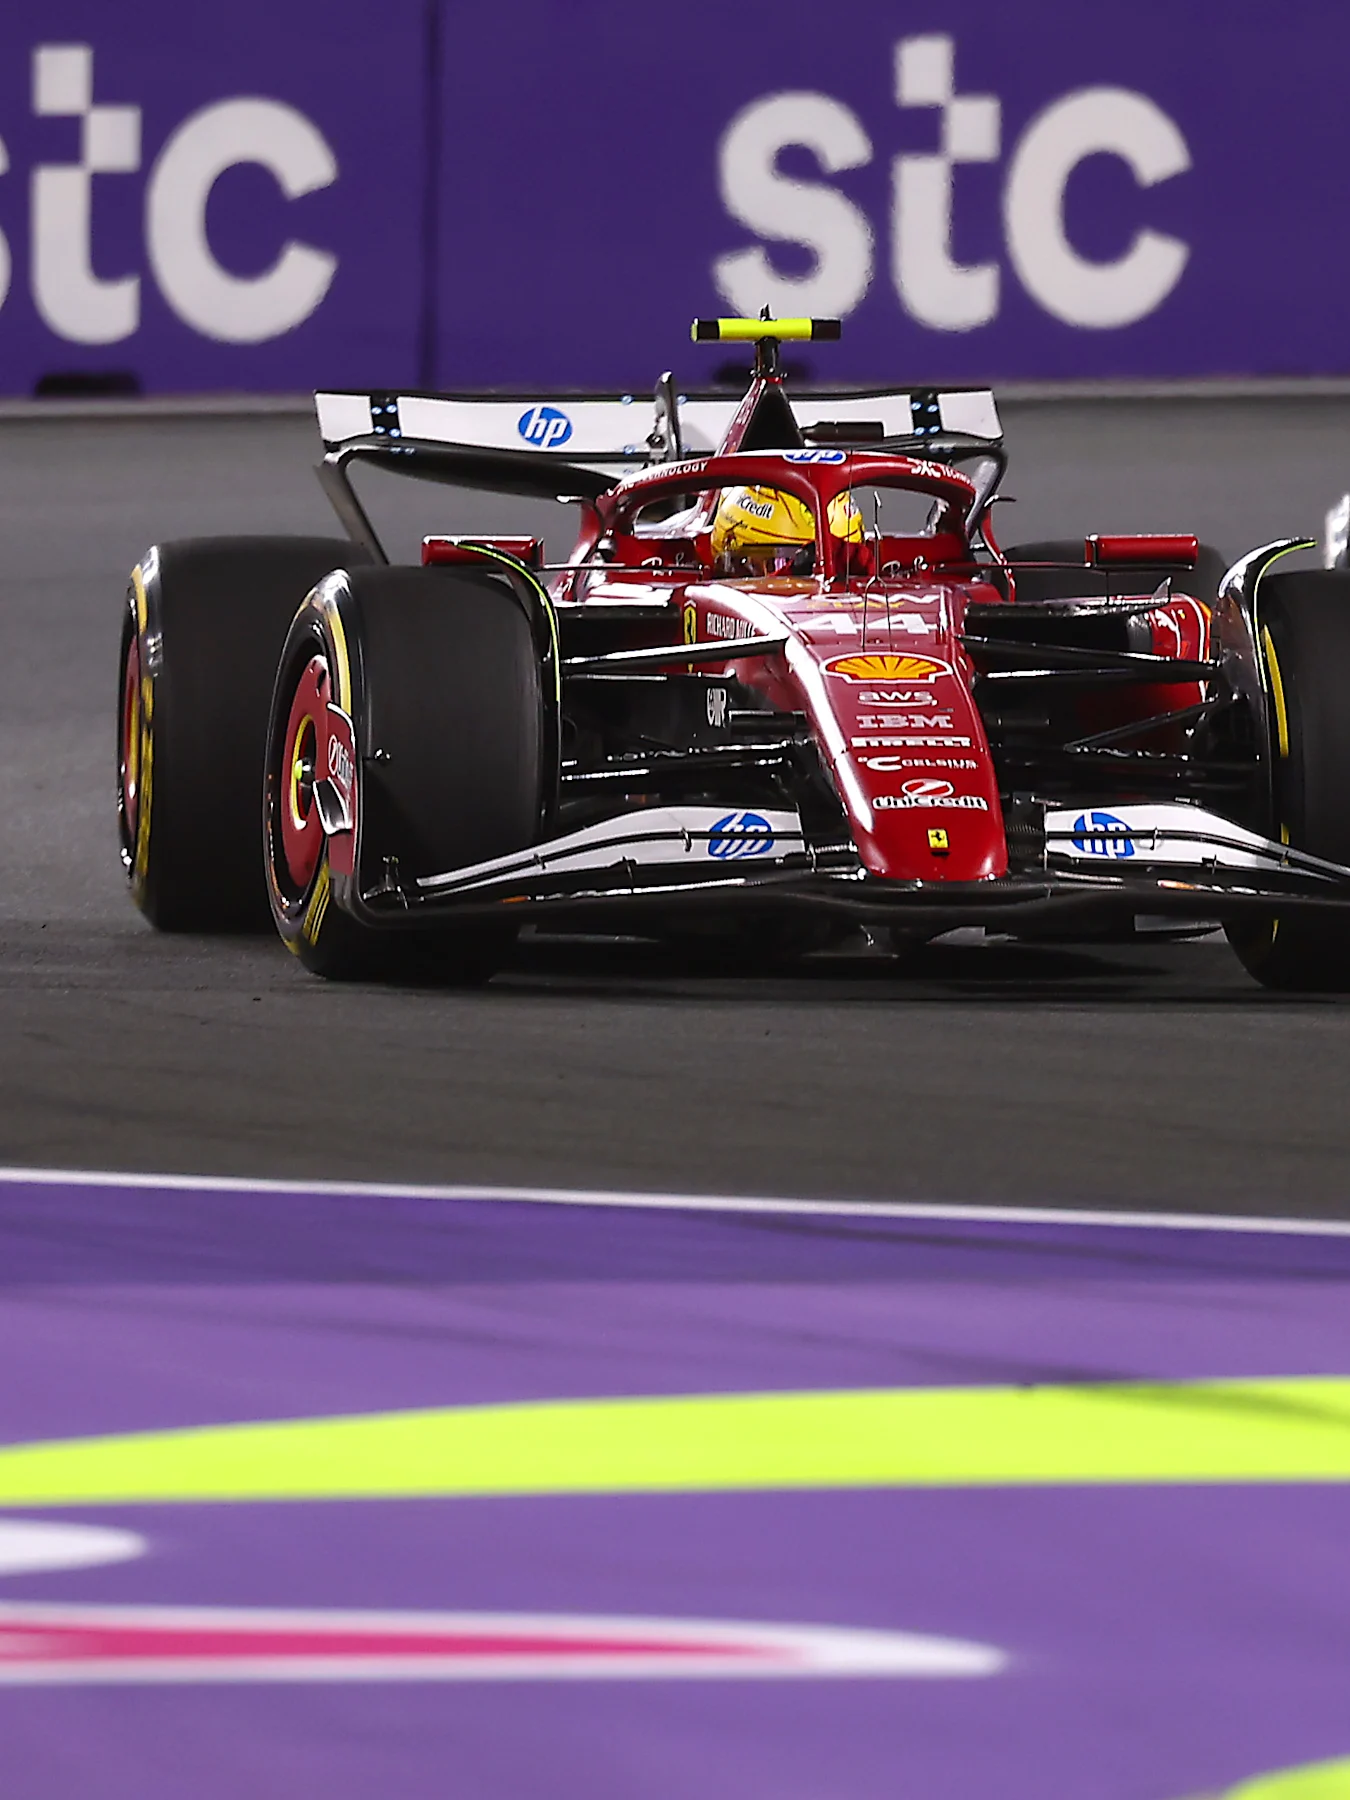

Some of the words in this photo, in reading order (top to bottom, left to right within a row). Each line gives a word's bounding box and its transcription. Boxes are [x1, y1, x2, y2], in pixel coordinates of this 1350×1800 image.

[713, 34, 1192, 331] stc
[0, 44, 338, 344] tc
[521, 405, 571, 448] hp
[736, 496, 773, 518] iCredit
[799, 613, 938, 634] 44
[858, 691, 935, 705] aws
[856, 714, 953, 728] IBM
[851, 736, 970, 747] PIRELLI
[873, 795, 988, 811] UniCredit
[711, 812, 770, 859] hp
[1079, 812, 1130, 858] hp
